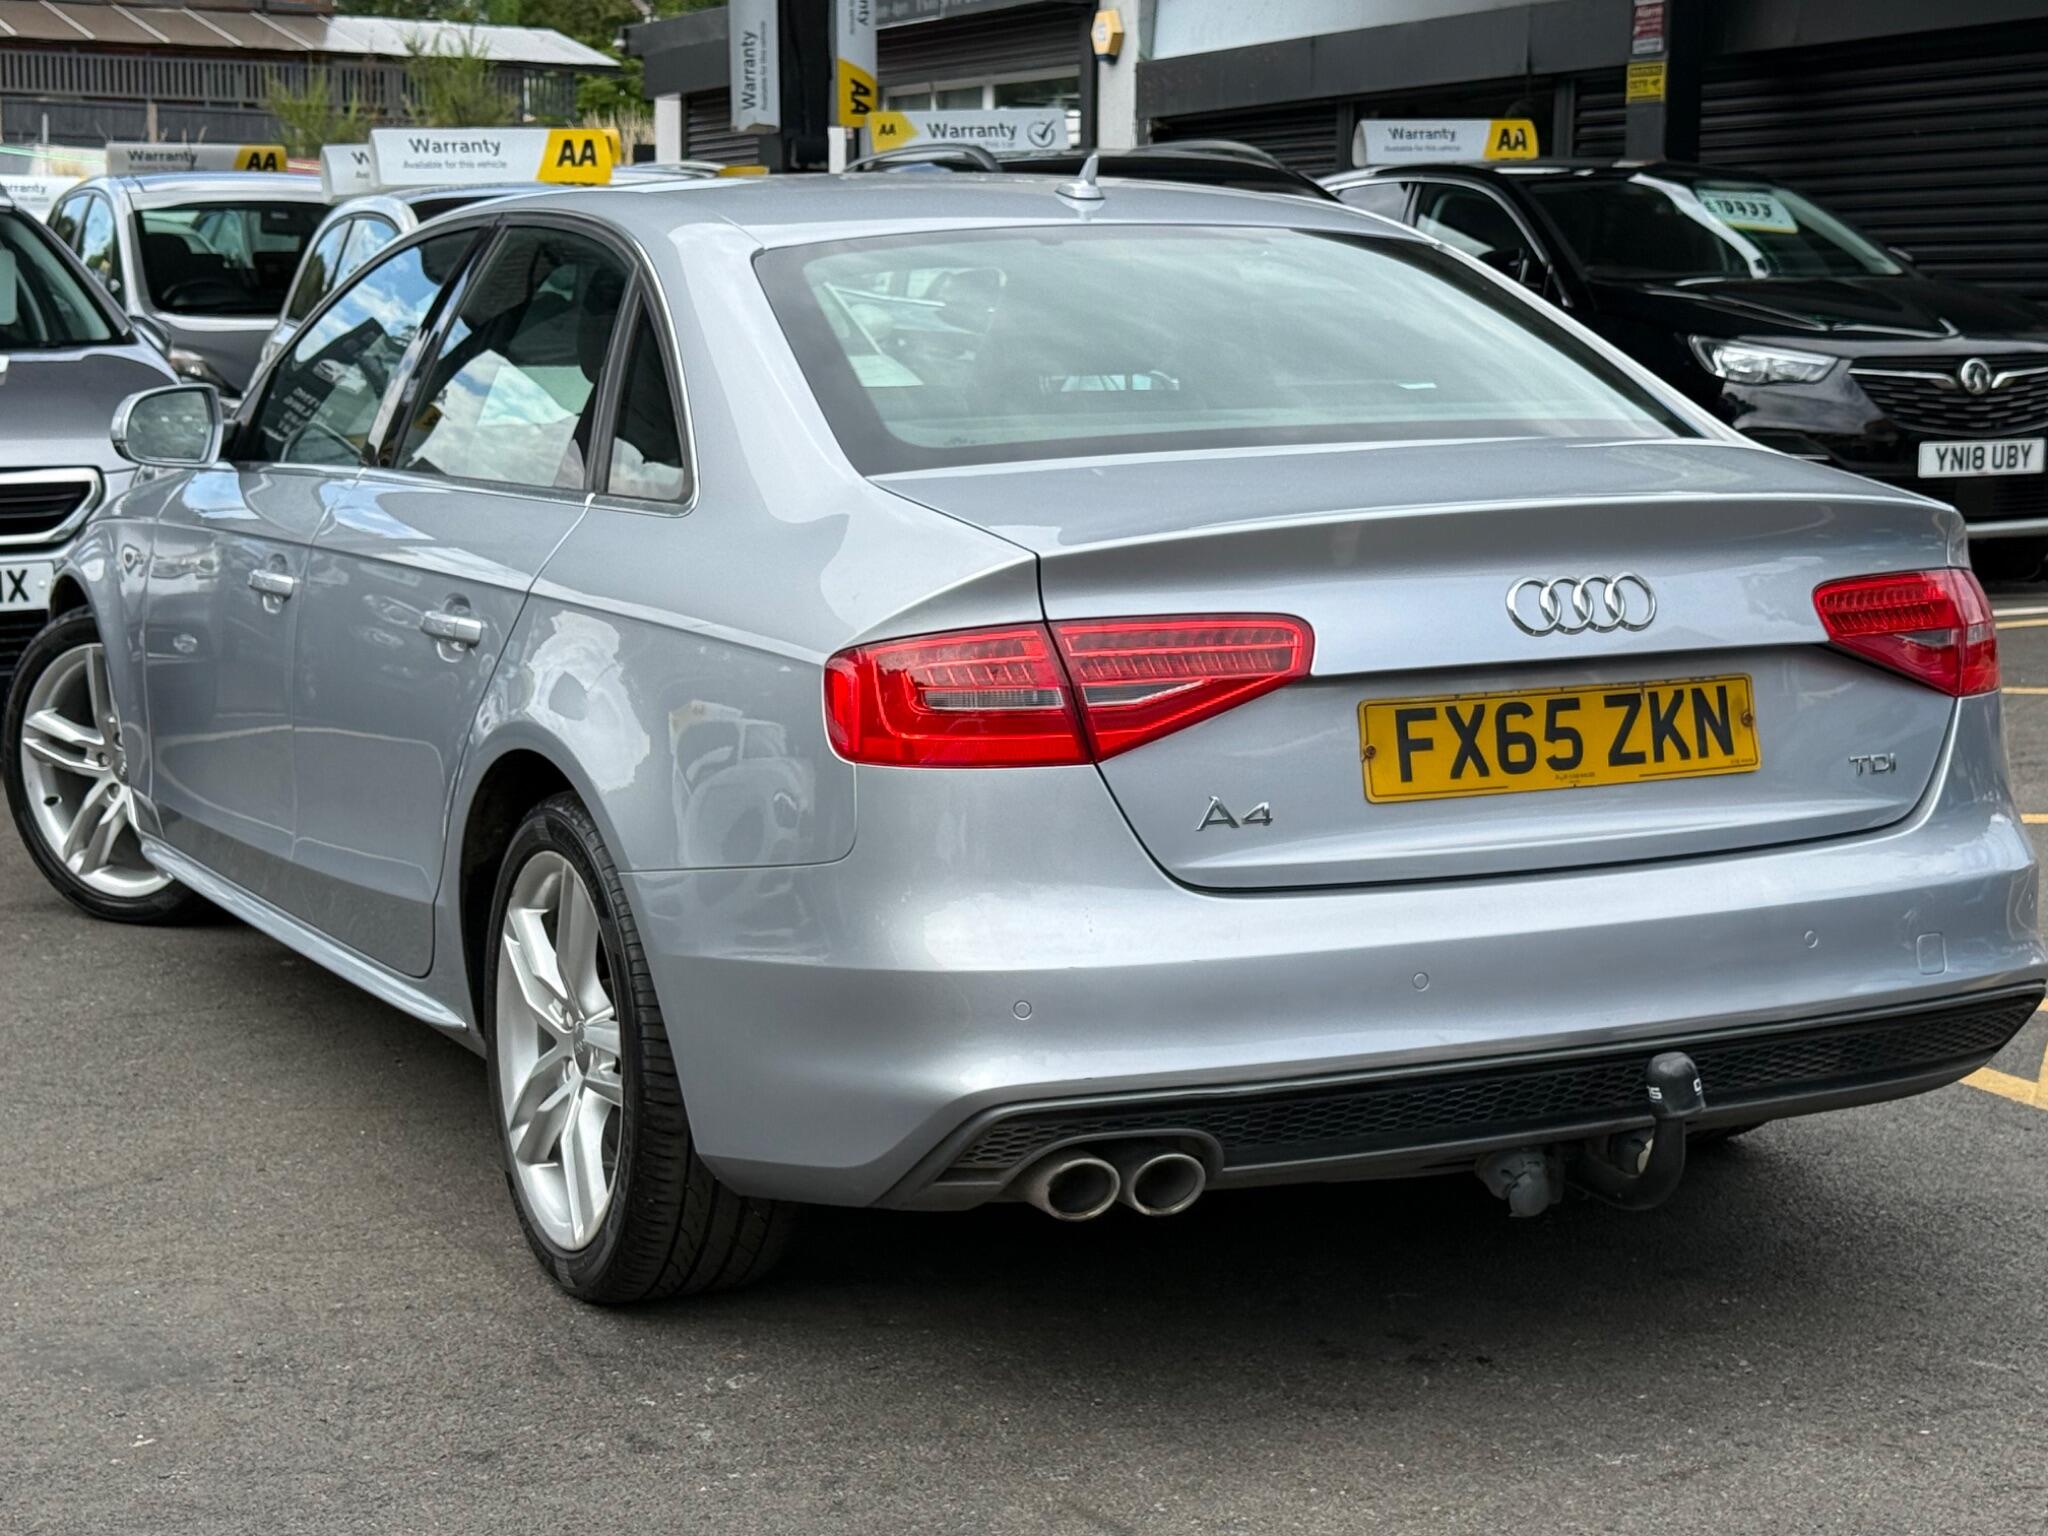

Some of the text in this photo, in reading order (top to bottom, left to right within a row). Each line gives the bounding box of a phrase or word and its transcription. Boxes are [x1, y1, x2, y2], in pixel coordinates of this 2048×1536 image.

[742, 30, 758, 110] Warranty
[850, 78, 871, 114] AA
[878, 123, 897, 136] AA
[926, 122, 1017, 141] Warranty
[1388, 127, 1456, 142] Warranty
[1497, 128, 1527, 151] AA
[127, 149, 198, 164] Warranty
[409, 137, 501, 156] Warranty
[556, 139, 597, 168] AA
[246, 152, 277, 171] AA
[1935, 444, 2032, 472] YN18 UBY
[1394, 685, 1735, 784] FX65 ZKN
[1196, 796, 1273, 832] A4
